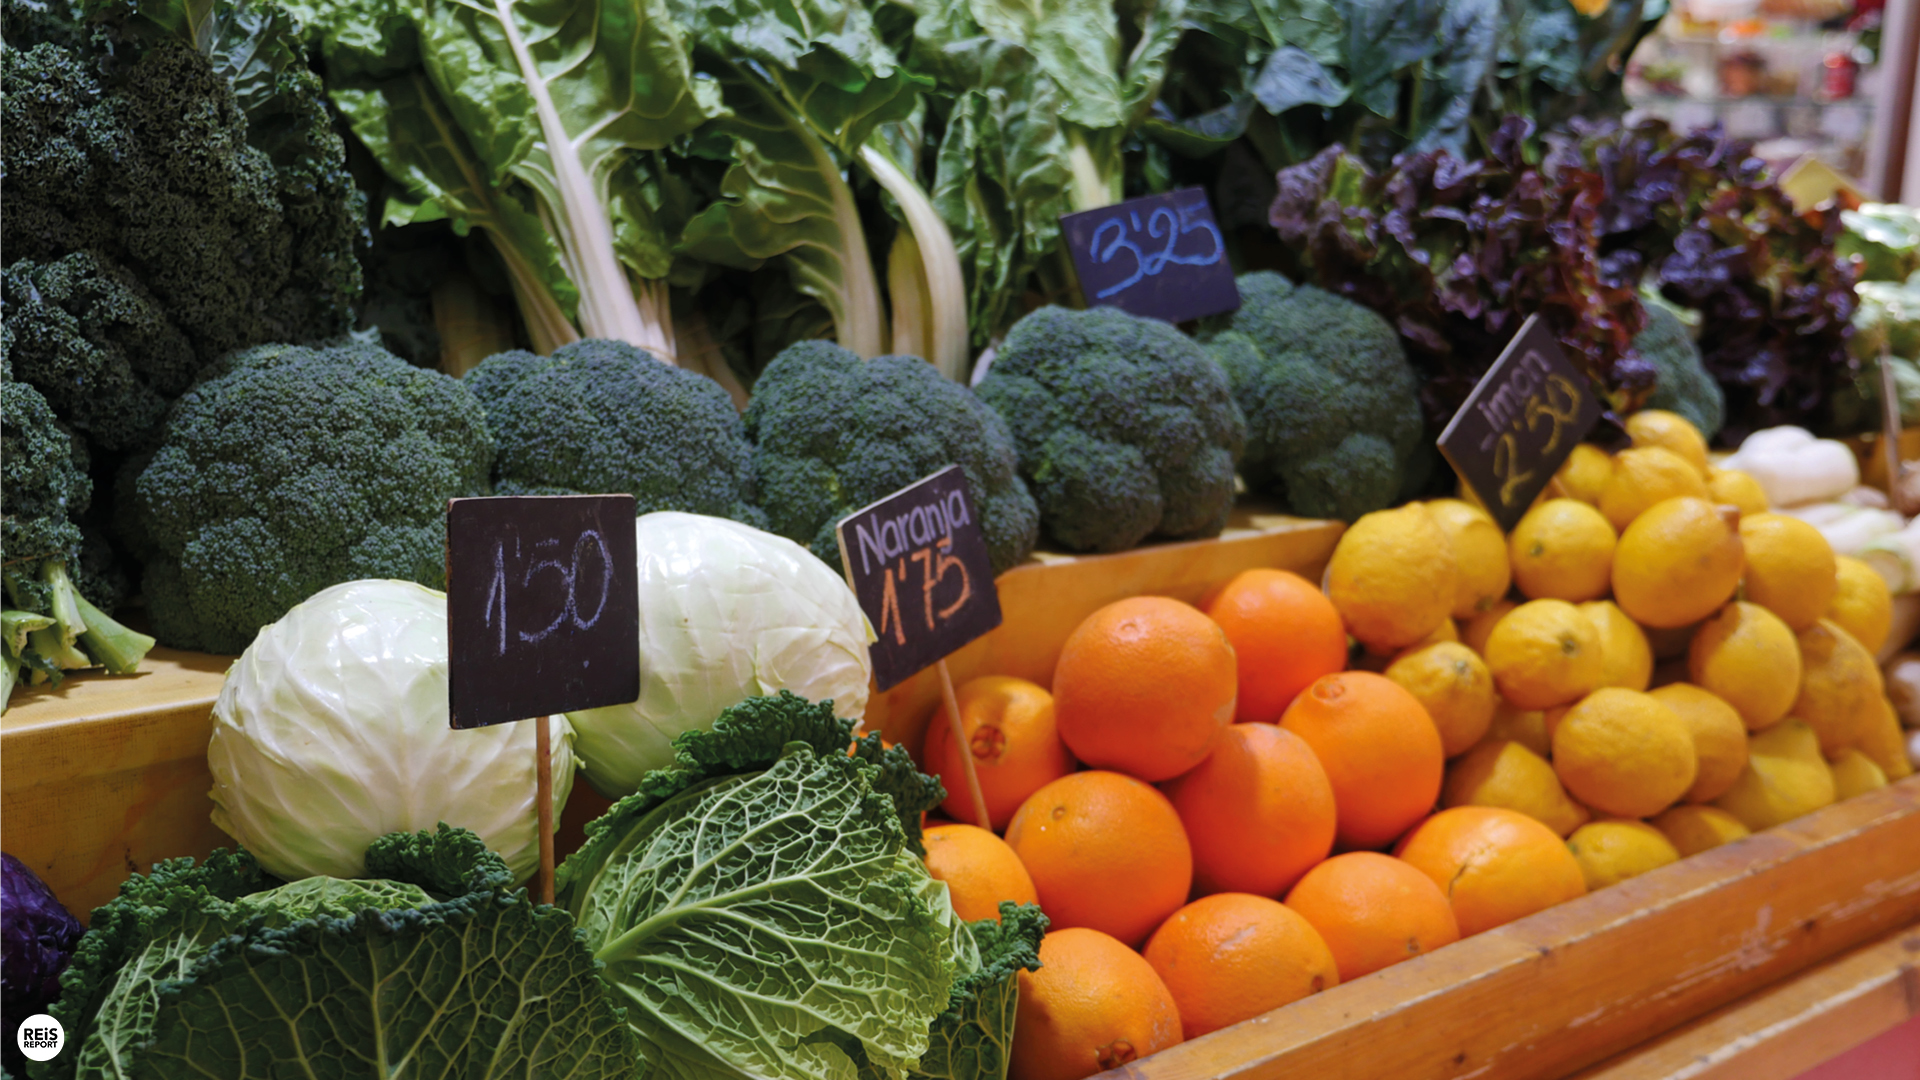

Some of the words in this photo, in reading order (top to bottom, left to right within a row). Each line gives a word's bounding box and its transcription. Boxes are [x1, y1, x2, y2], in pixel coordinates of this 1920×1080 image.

[1089, 202, 1225, 299] 3'25
[1493, 373, 1582, 507] 2'50
[855, 489, 971, 575] Naranja
[485, 529, 614, 655] 1'50
[880, 537, 972, 645] 1'75
